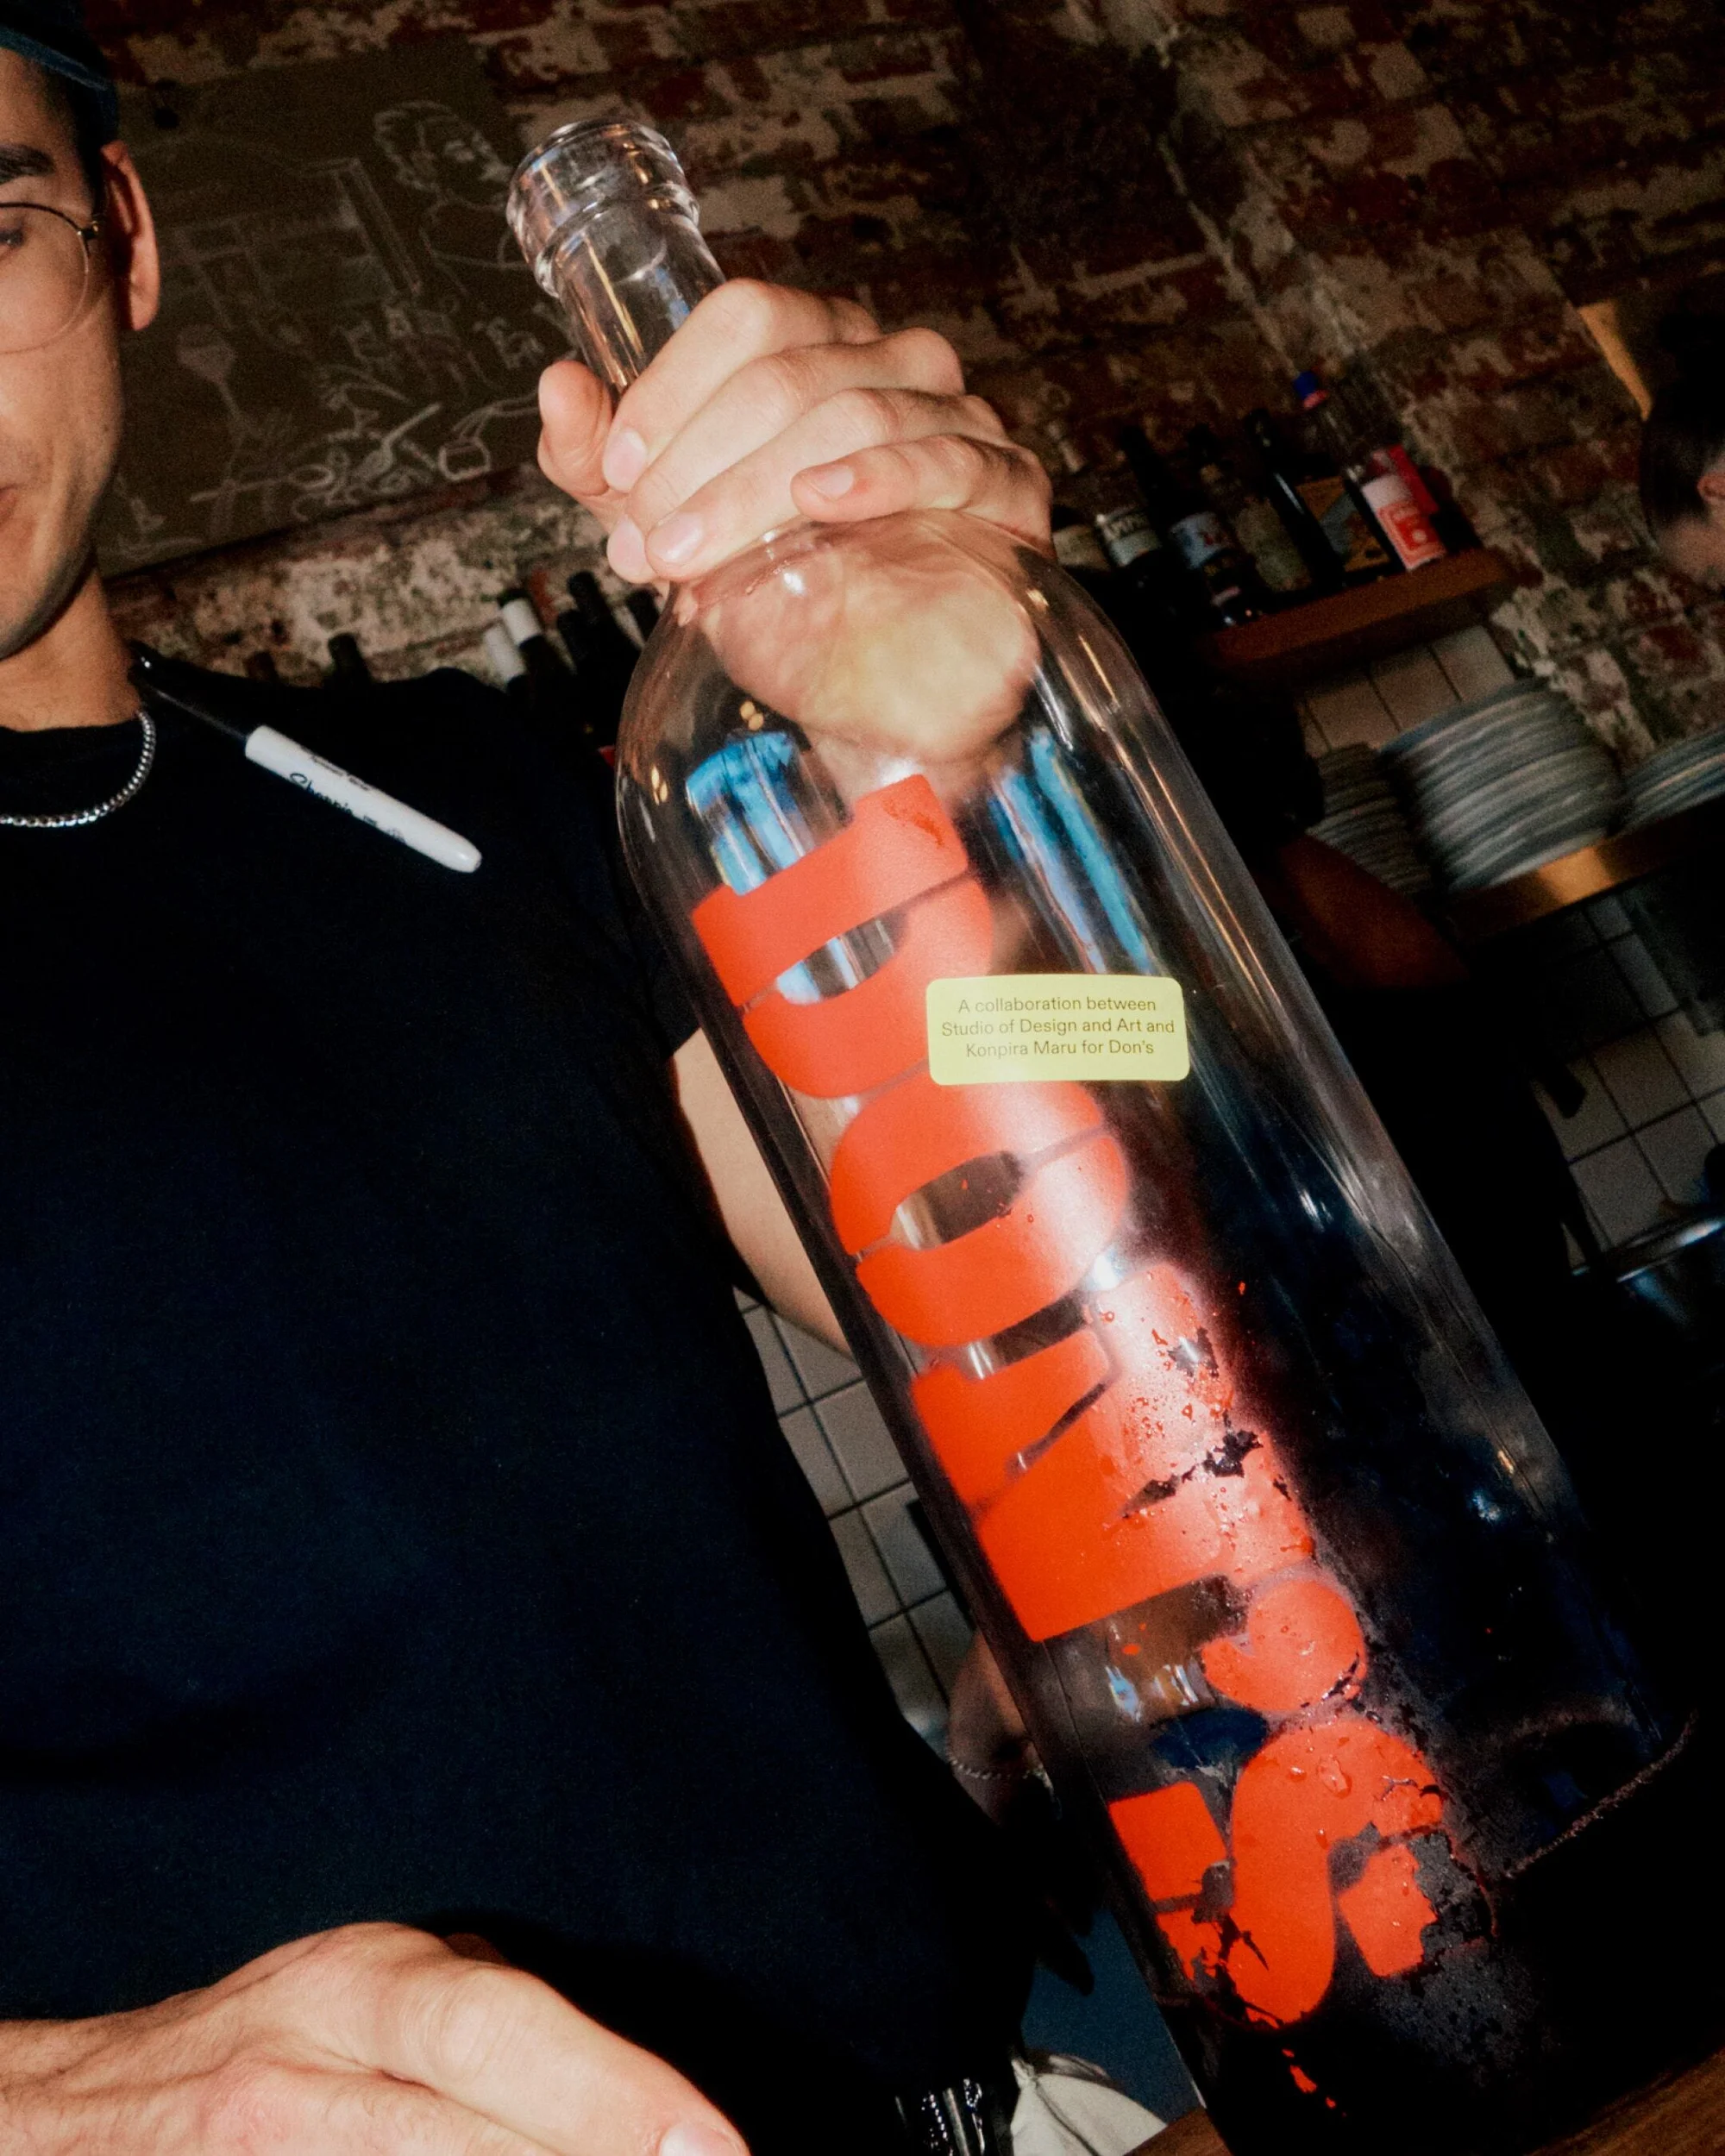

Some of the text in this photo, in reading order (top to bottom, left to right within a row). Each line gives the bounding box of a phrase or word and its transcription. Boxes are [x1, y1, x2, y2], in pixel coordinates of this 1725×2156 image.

[957, 996, 1156, 1013] A collaboration between
[942, 1018, 1176, 1037] Studio of Design and Art and
[966, 1039, 1154, 1058] Konpira Maru for Don's
